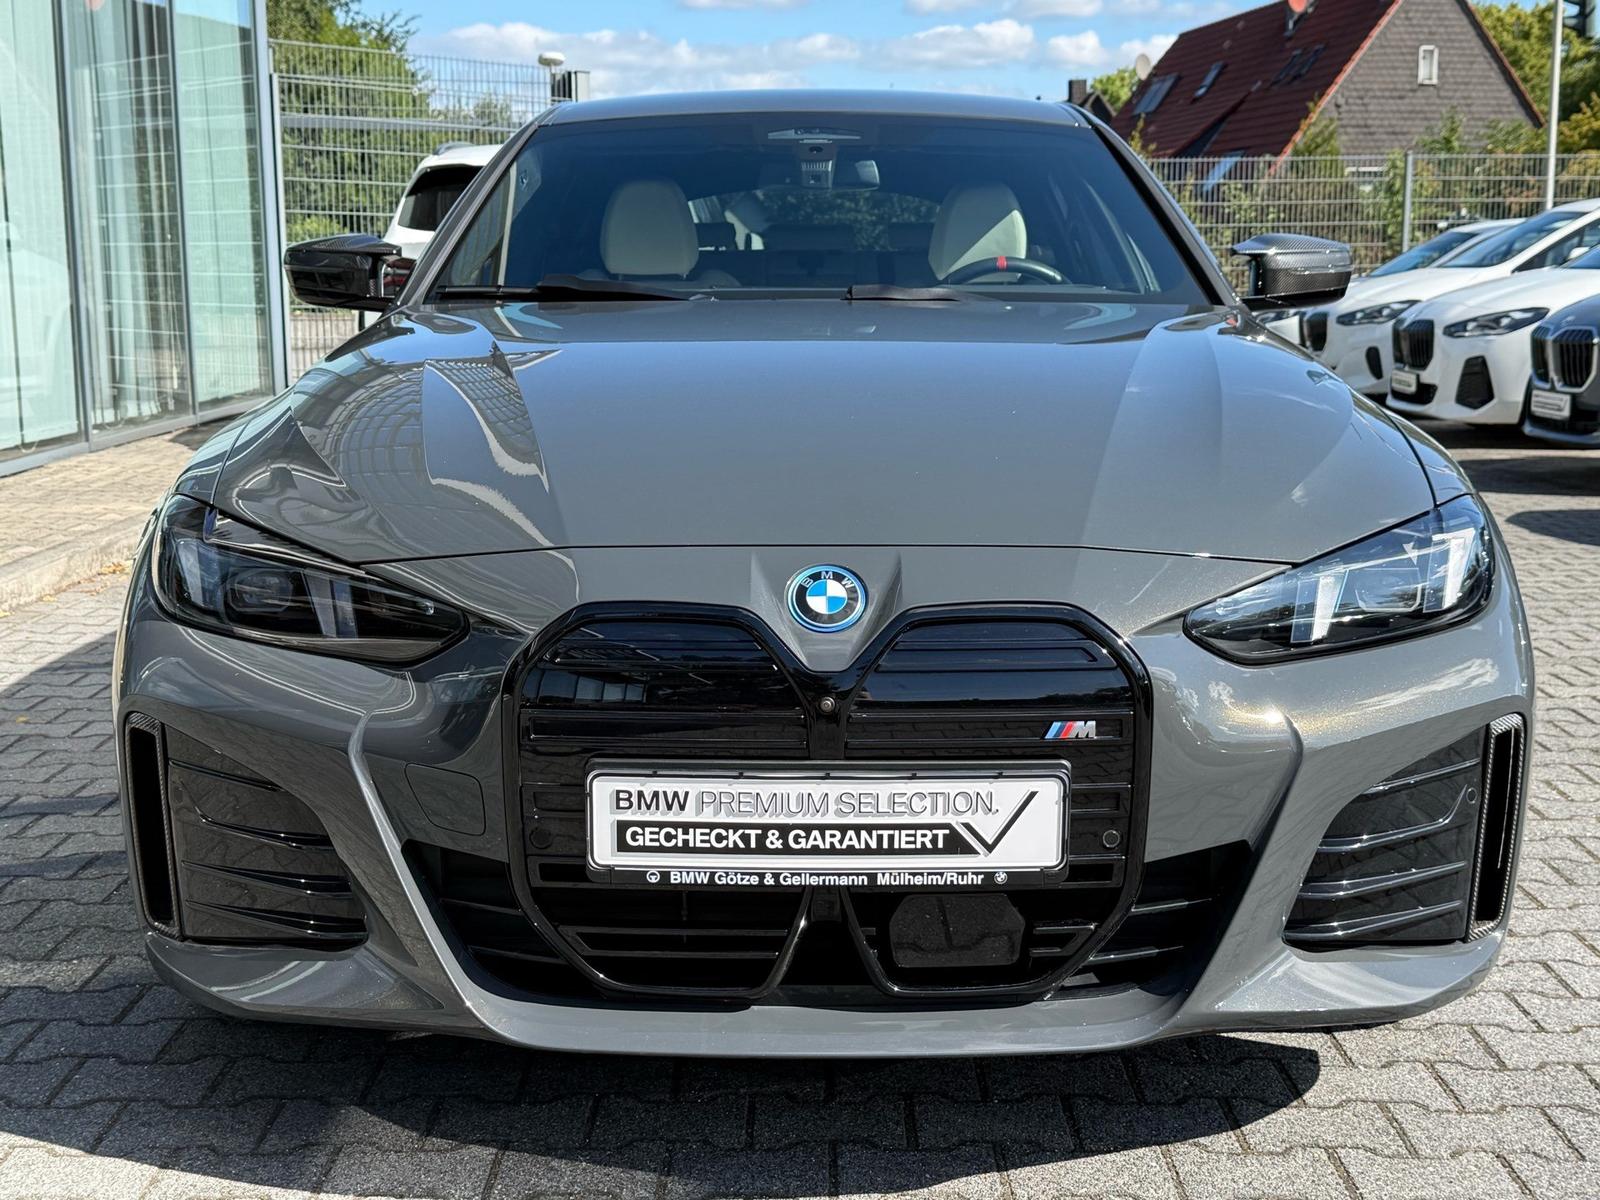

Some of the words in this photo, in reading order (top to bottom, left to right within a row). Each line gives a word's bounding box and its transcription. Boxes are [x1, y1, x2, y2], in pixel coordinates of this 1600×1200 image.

[801, 571, 855, 589] BMW
[615, 789, 690, 812] BMW
[700, 791, 829, 814] PREMIUM
[625, 826, 762, 848] GECHECKT
[765, 829, 783, 849] &
[788, 829, 950, 849] GARANTIERT
[670, 871, 710, 884] BMW
[714, 872, 759, 885] Götze
[763, 873, 775, 885] &
[779, 872, 868, 886] Gellermann
[876, 871, 985, 885] Mülheim/Ruhr
